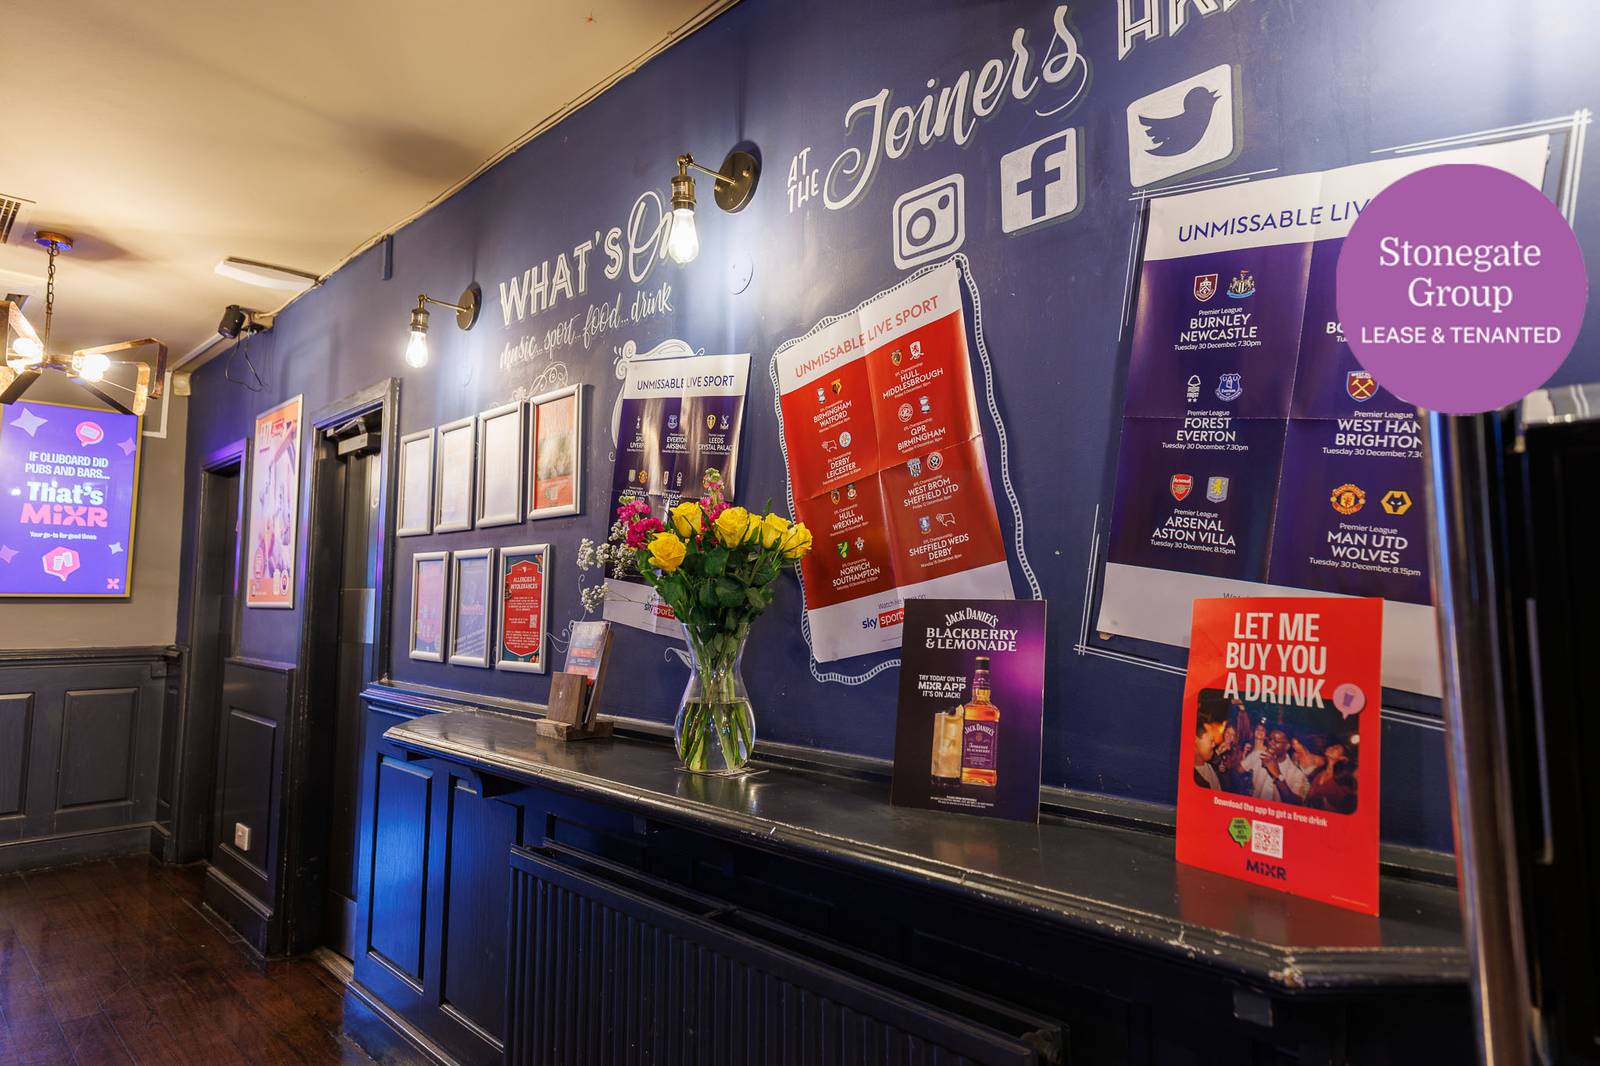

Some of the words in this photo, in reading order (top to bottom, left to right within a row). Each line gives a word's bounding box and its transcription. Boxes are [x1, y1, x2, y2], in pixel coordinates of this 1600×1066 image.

[822, 5, 1087, 210] Joiners
[788, 147, 811, 188] AT
[787, 168, 819, 213] THE
[1178, 206, 1323, 242] UNMISSABLE
[1331, 198, 1371, 221] LIV
[499, 227, 623, 326] WHAT'S
[1198, 308, 1220, 316] Premier
[1220, 307, 1242, 315] League
[1190, 313, 1252, 329] BURNLEY
[795, 333, 866, 378] UNMISSABLE
[867, 317, 893, 341] LIVE
[896, 295, 938, 326] SPORT
[1180, 326, 1258, 342] NEWCASTLE
[637, 377, 684, 391] UNMISSABLE
[686, 376, 702, 388] LIVE
[703, 375, 735, 387] SPORT
[882, 368, 944, 399] MIDDLESBROUGH
[900, 369, 920, 382] HULL
[813, 400, 852, 424] BIRMINGHAM
[819, 410, 848, 427] WATFORD
[1354, 410, 1383, 418] Premier
[1384, 411, 1414, 420] League
[910, 424, 927, 436] QPR
[1184, 417, 1231, 429] FOREST
[1337, 418, 1382, 432] WEST
[897, 427, 946, 451] BIRMINGHAM
[1176, 430, 1236, 442] EVERTON
[1162, 442, 1186, 450] Tuesday
[1323, 447, 1353, 456] Tuesday
[1354, 448, 1365, 456] 30
[29, 451, 40, 462] IF
[92, 457, 109, 468] DID
[830, 456, 850, 470] DERBY
[25, 462, 52, 475] PUBS
[53, 465, 76, 477] AND
[826, 462, 856, 479] LEICESTER
[27, 480, 105, 505] That's
[903, 489, 942, 507] SHEFFIELD
[942, 483, 959, 495] UTD
[907, 485, 927, 496] WEST
[927, 477, 951, 491] BROM
[839, 509, 855, 521] HULL
[1174, 508, 1196, 516] Premier
[832, 515, 864, 531] WREXHAM
[1165, 516, 1225, 531] ARSENAL
[1339, 523, 1368, 533] Premier
[1369, 525, 1398, 535] League
[908, 540, 947, 557] SHEFFIELD
[948, 533, 970, 545] WEDS
[1150, 539, 1174, 548] Tuesday
[1152, 528, 1196, 541] ASTON
[1198, 531, 1236, 546] VILLA
[1327, 530, 1367, 546] MAN
[1371, 535, 1408, 550] UTD
[928, 547, 953, 561] DERBY
[1330, 544, 1400, 564] WOLVES
[840, 561, 871, 577] NORWICH
[1309, 557, 1341, 568] Tuesday
[1341, 560, 1351, 568] 30
[1392, 567, 1421, 577] 8.15pm
[832, 566, 881, 587] SOUTHAMPTON
[862, 617, 878, 629] sky
[881, 611, 904, 625] sport
[945, 610, 966, 627] JACK
[966, 607, 999, 628] DANIEL'S
[926, 627, 1018, 641] BLACKBERRY
[1233, 612, 1274, 641] LET
[1278, 612, 1321, 642] ME
[925, 638, 935, 649] &
[937, 638, 1017, 652] LEMONADE
[1226, 642, 1273, 671] BUY
[1276, 645, 1327, 676] YOU
[943, 682, 967, 692] APP
[1223, 672, 1240, 700] A
[1245, 673, 1326, 709] DRINK
[1213, 796, 1243, 810] Download
[1243, 802, 1254, 812] the
[1254, 806, 1267, 816] app
[1267, 807, 1275, 816] to
[1275, 809, 1287, 819] get
[1293, 812, 1308, 823] free
[1308, 815, 1328, 827] drink
